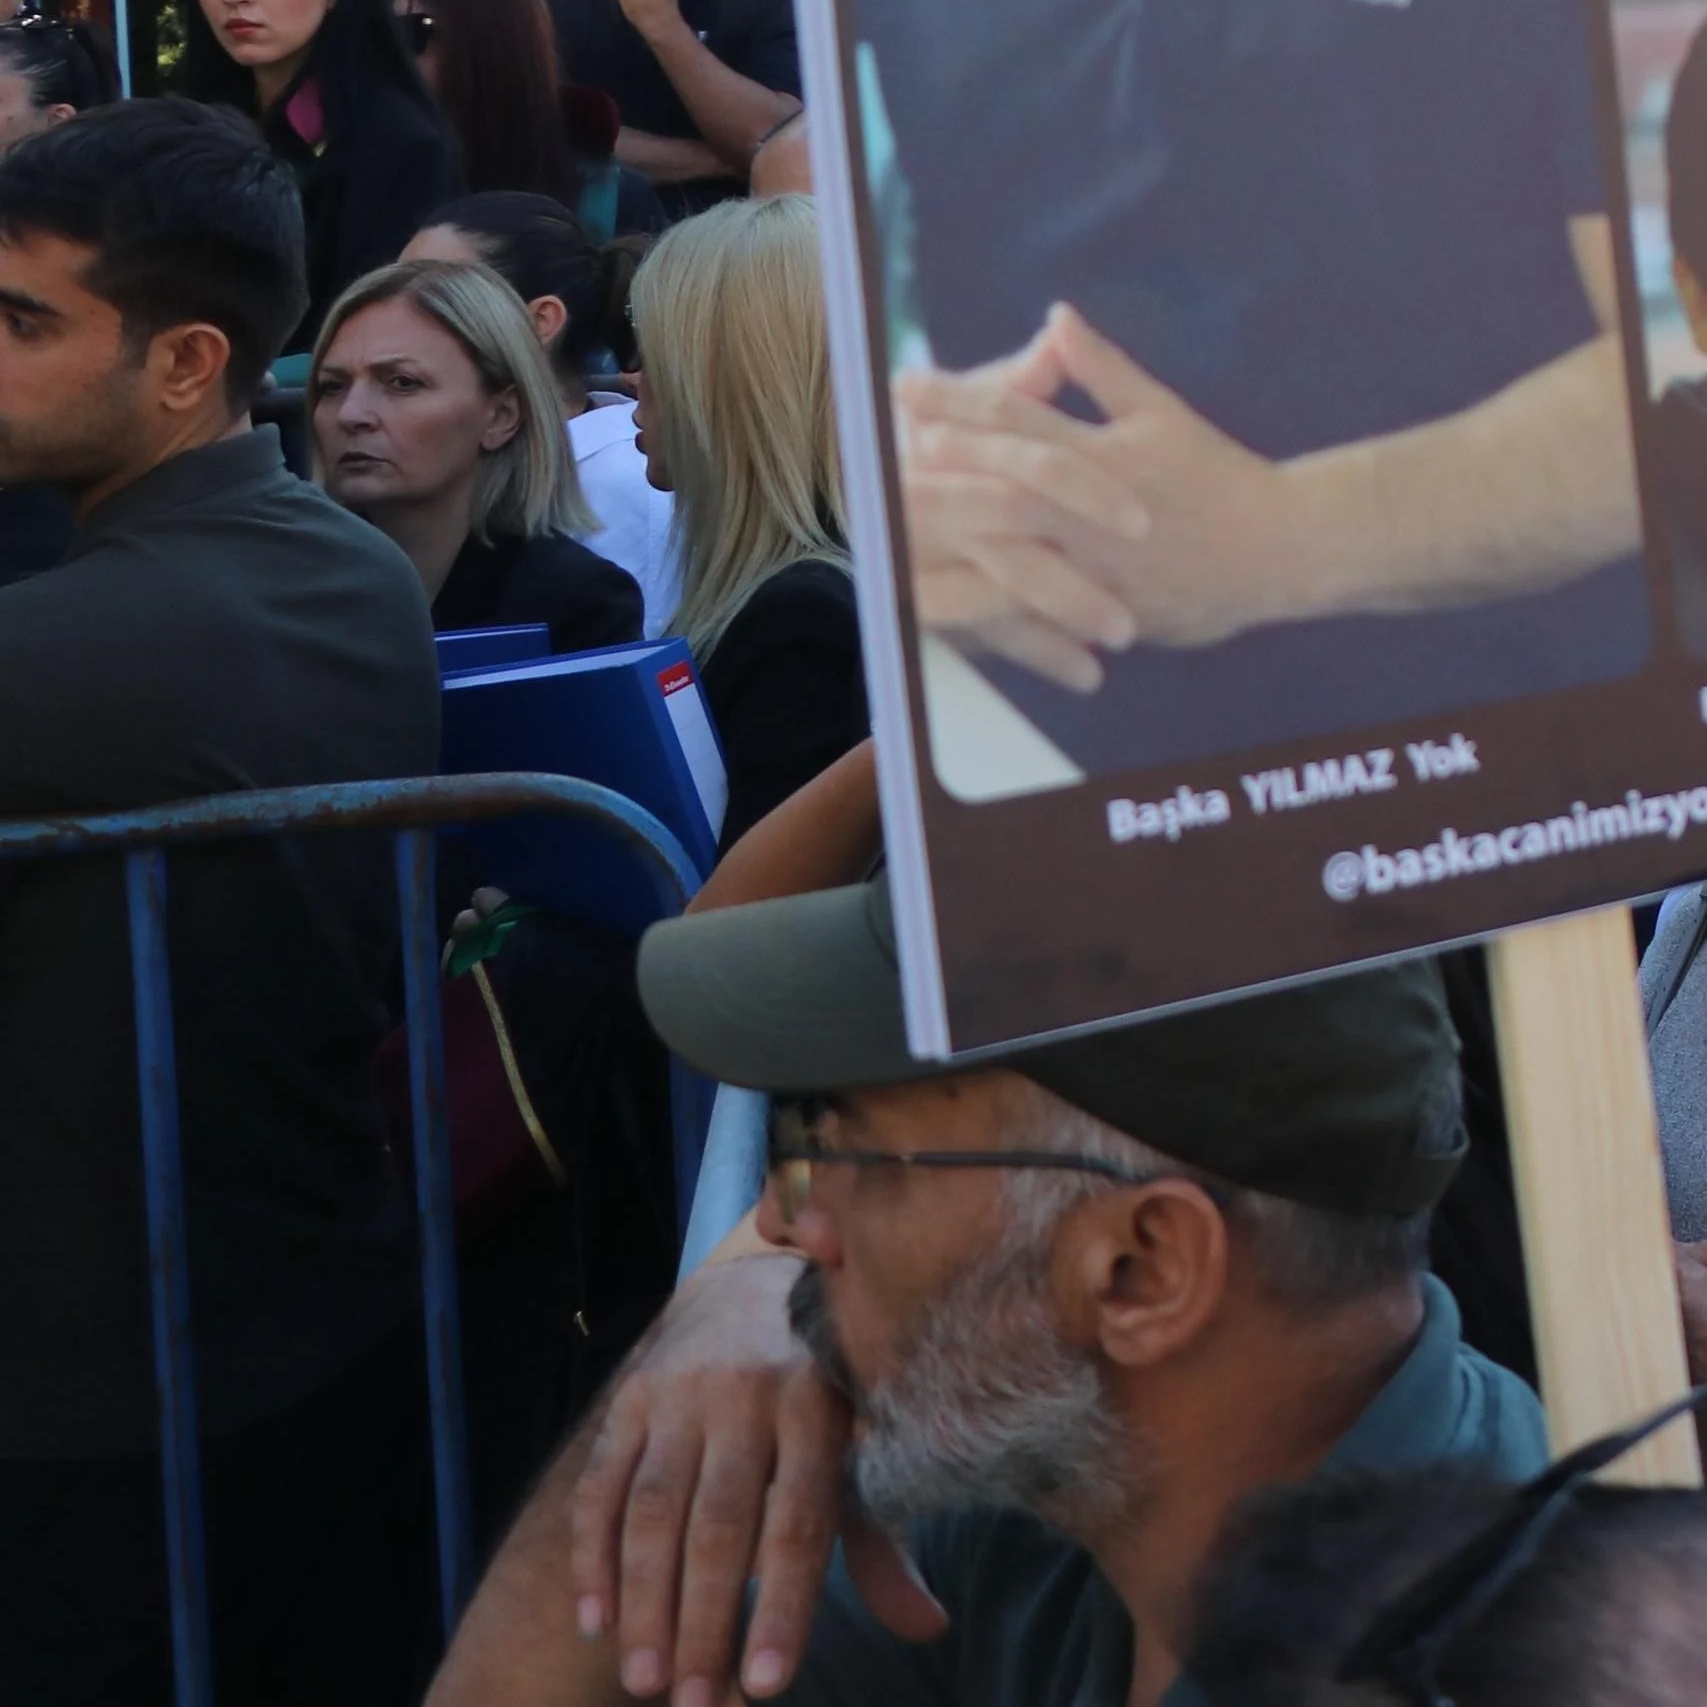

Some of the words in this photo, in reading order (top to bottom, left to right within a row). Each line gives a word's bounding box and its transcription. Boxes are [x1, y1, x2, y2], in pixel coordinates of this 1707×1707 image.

[1107, 785, 1230, 842] Başka
[1242, 749, 1397, 816] YILMAZ
[1406, 733, 1481, 782] Yok
